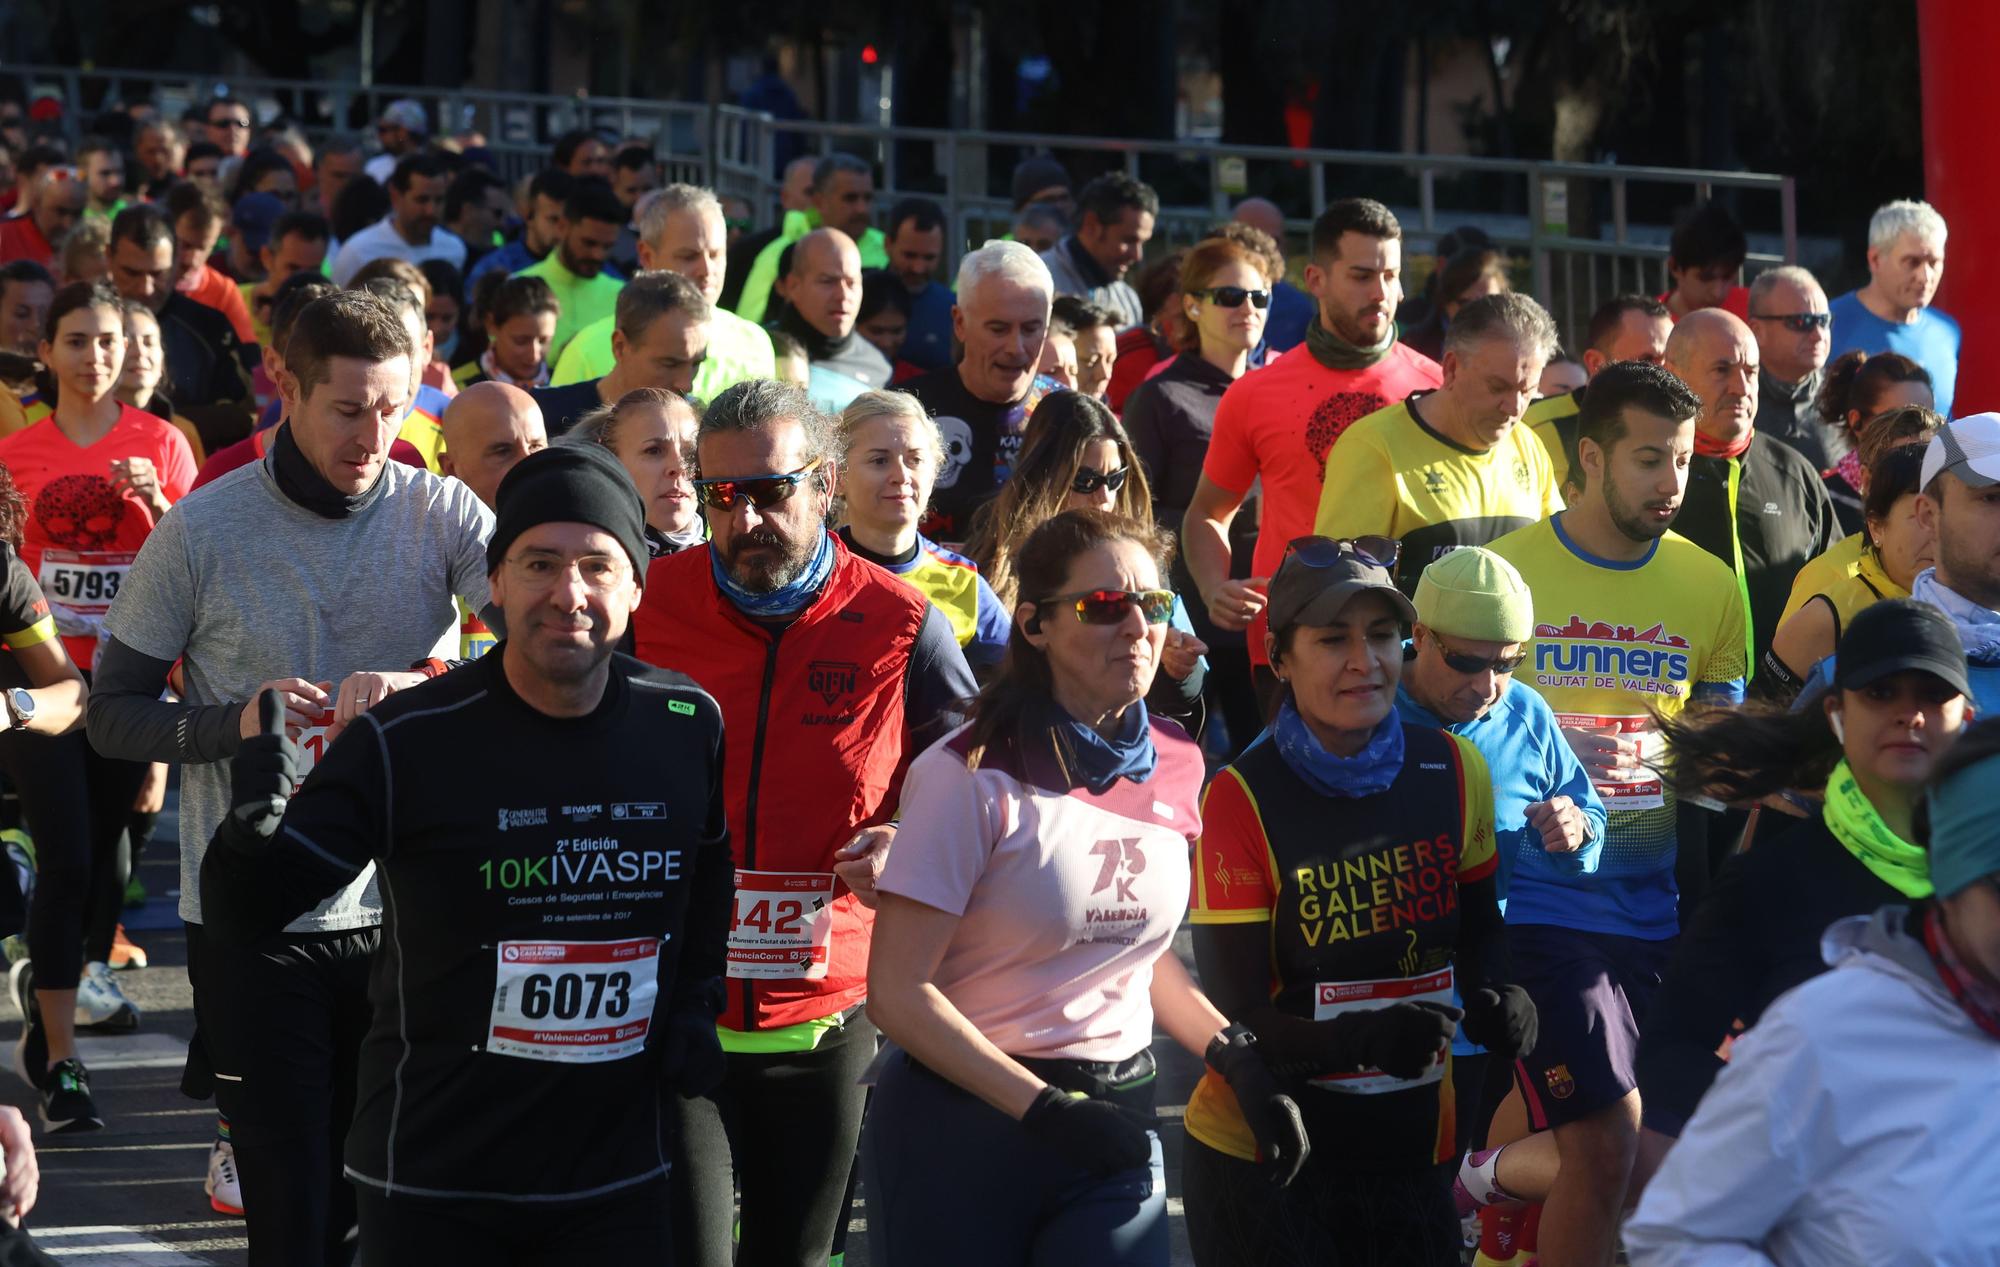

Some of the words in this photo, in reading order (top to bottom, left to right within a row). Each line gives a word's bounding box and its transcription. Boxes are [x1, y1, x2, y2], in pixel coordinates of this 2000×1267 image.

[54, 569, 120, 599] 5793
[1536, 643, 1688, 681] runners
[1537, 675, 1588, 687] CIUTAT
[1595, 677, 1615, 688] DE
[1622, 679, 1685, 697] VALÈNCIA
[572, 805, 602, 814] IVASPE
[509, 817, 548, 828] VALENCIANA
[573, 837, 618, 852] Edición
[1297, 834, 1455, 894] RUNNERS
[508, 896, 543, 906] Cossos
[545, 894, 557, 903] de
[560, 891, 604, 904] Seguretat
[1301, 861, 1457, 920] GALENOS
[555, 914, 564, 922] de
[566, 913, 600, 923] setembre
[603, 912, 612, 921] de
[614, 911, 632, 921] 2017
[521, 971, 632, 1020] 6073
[534, 1032, 609, 1043] #ValènciaCorre
